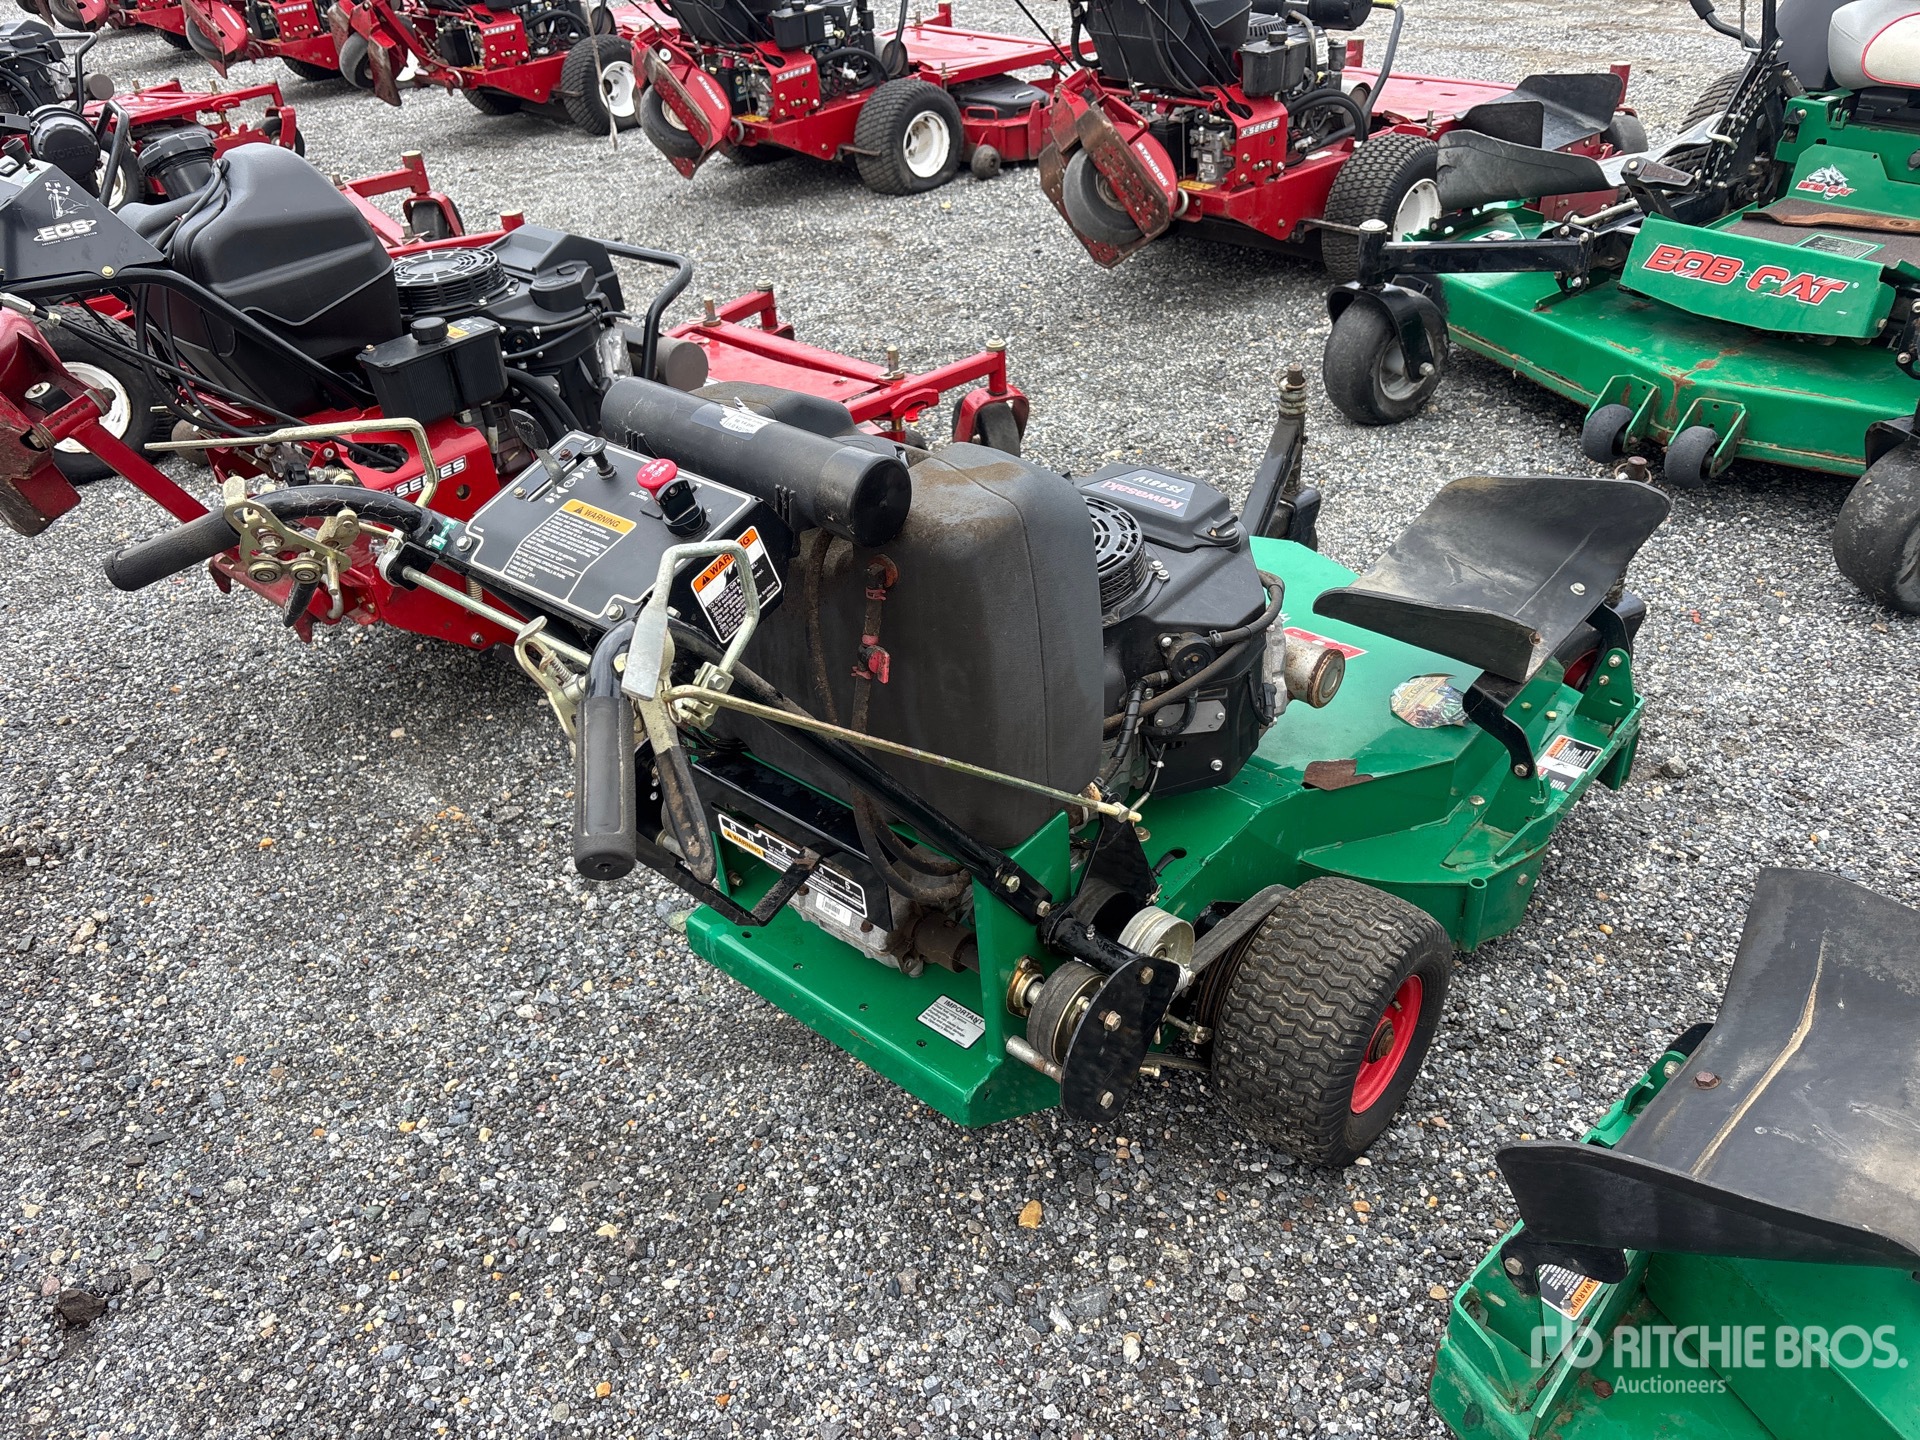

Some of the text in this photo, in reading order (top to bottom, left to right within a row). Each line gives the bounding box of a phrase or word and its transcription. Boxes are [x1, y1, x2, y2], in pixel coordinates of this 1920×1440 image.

[1136, 142, 1170, 186] STANDON
[36, 217, 91, 241] ECS
[1100, 480, 1184, 509] Kawasaki
[1133, 475, 1185, 493] FS481V
[583, 509, 620, 528] WARNING
[708, 601, 714, 609] TO
[714, 587, 730, 604] CHECK
[729, 581, 737, 590] OR
[729, 822, 736, 832] R
[747, 832, 754, 842] N
[780, 844, 786, 854] 2
[844, 880, 850, 890] 5
[731, 833, 761, 855] WARNING
[943, 999, 984, 1024] IMPORTANT
